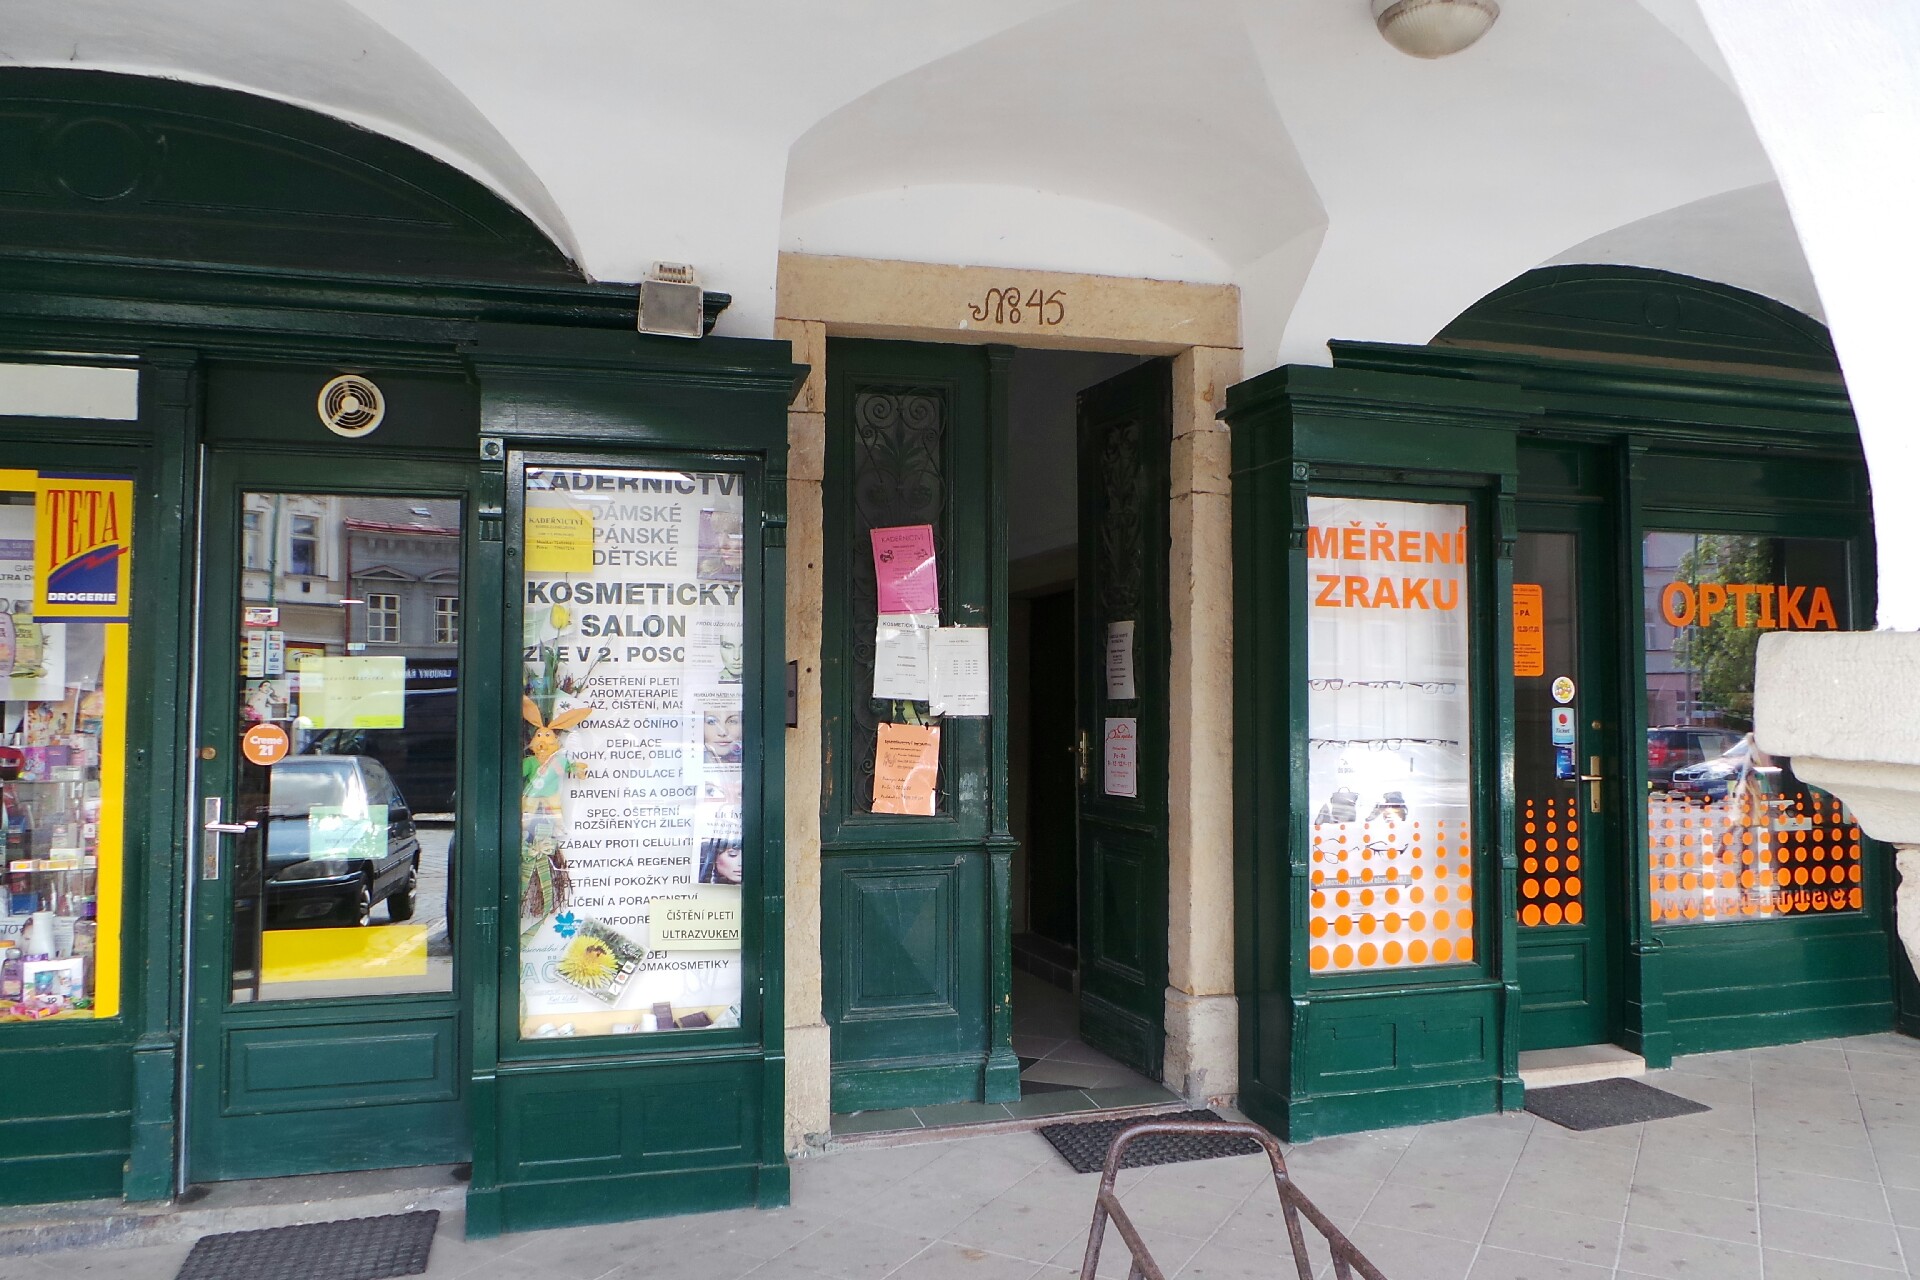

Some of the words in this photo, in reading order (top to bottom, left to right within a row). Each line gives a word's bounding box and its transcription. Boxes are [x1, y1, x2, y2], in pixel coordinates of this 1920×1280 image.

[1025, 289, 1067, 325] 45
[593, 501, 682, 524] DÁMSKÉ
[46, 489, 120, 572] TETA
[593, 524, 679, 544] PÁNSKÉ
[1307, 521, 1468, 565] MĚŘENÍ
[592, 547, 678, 567] DĚTSKÉ
[48, 592, 117, 603] DROGERIE
[1315, 575, 1458, 611] ZRAKU
[1662, 581, 1838, 629] OPTIKA
[581, 614, 686, 637] SALON
[577, 646, 591, 662] V
[597, 646, 619, 663] 2.
[588, 676, 647, 686] OŠETŘENÍ
[649, 676, 680, 686] PLETI
[590, 688, 679, 699] AROMATERAPIE
[633, 718, 679, 729] OČNÍHO
[606, 738, 662, 748] DEPILACE
[258, 745, 274, 756] 21
[571, 751, 607, 761] NOHY,
[610, 750, 646, 761] RUCE,
[612, 769, 675, 779] ONDULACE
[570, 788, 620, 799] BARVENÍ
[623, 787, 647, 798] ŘAS
[649, 788, 657, 797] A
[660, 785, 697, 797] OBOČÍ
[586, 808, 620, 818] SPEC.
[623, 805, 680, 817] OŠETŘENÍ
[574, 819, 657, 830] ROZŠÍŘENÝCH
[659, 817, 691, 828] ŽILEK
[559, 839, 603, 850] ZÁBALY
[605, 838, 639, 849] PROTI
[637, 856, 691, 866] REGENER
[614, 874, 669, 887] POKOŽKY
[567, 896, 604, 908] LÍČENÍ
[607, 897, 616, 906] A
[666, 910, 705, 921] ČIŠTĚNÍ
[707, 911, 734, 921] PLETI
[662, 929, 739, 940] ULTRAZVUKEM
